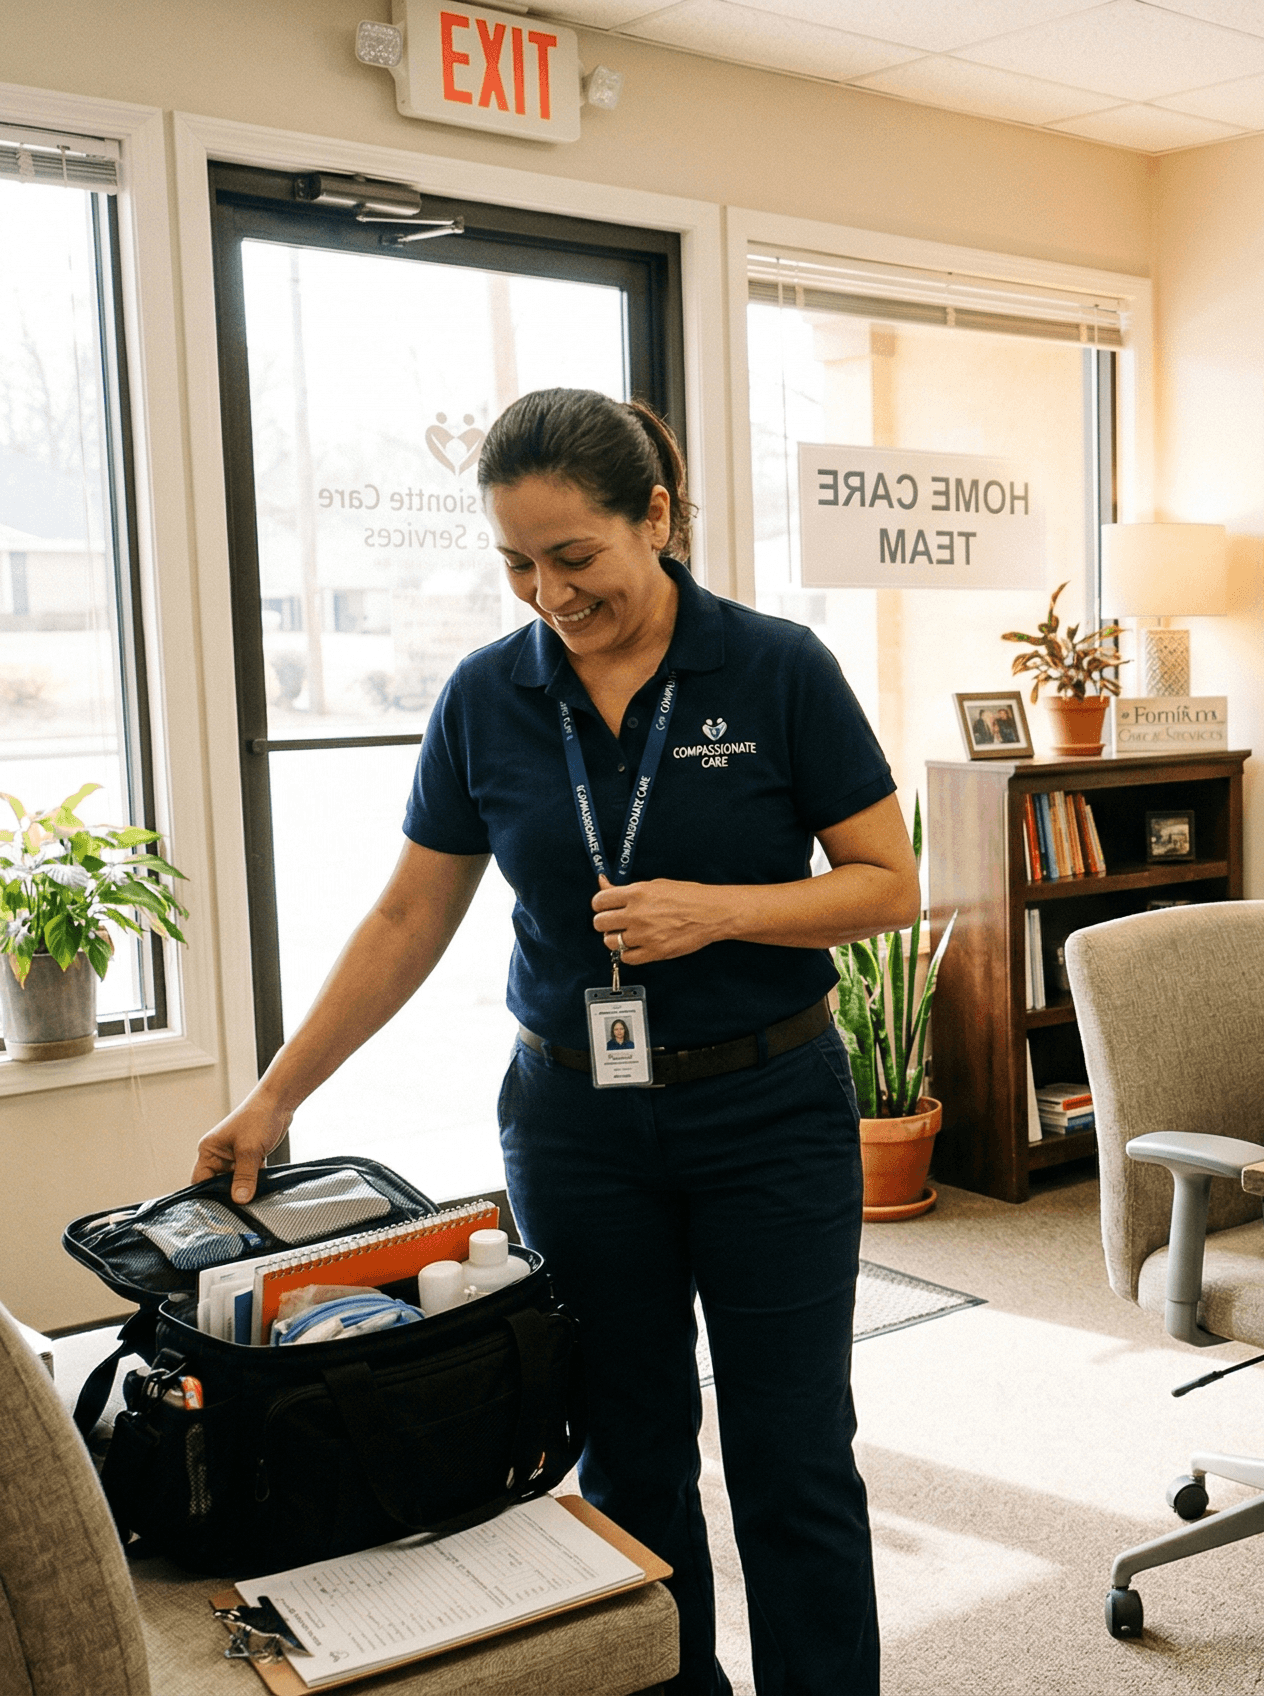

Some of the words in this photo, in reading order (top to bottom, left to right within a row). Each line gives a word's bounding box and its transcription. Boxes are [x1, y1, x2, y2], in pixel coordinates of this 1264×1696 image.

[441, 11, 557, 120] EXIT
[673, 741, 757, 759] COMPASSIONATE
[701, 756, 729, 768] CARE
